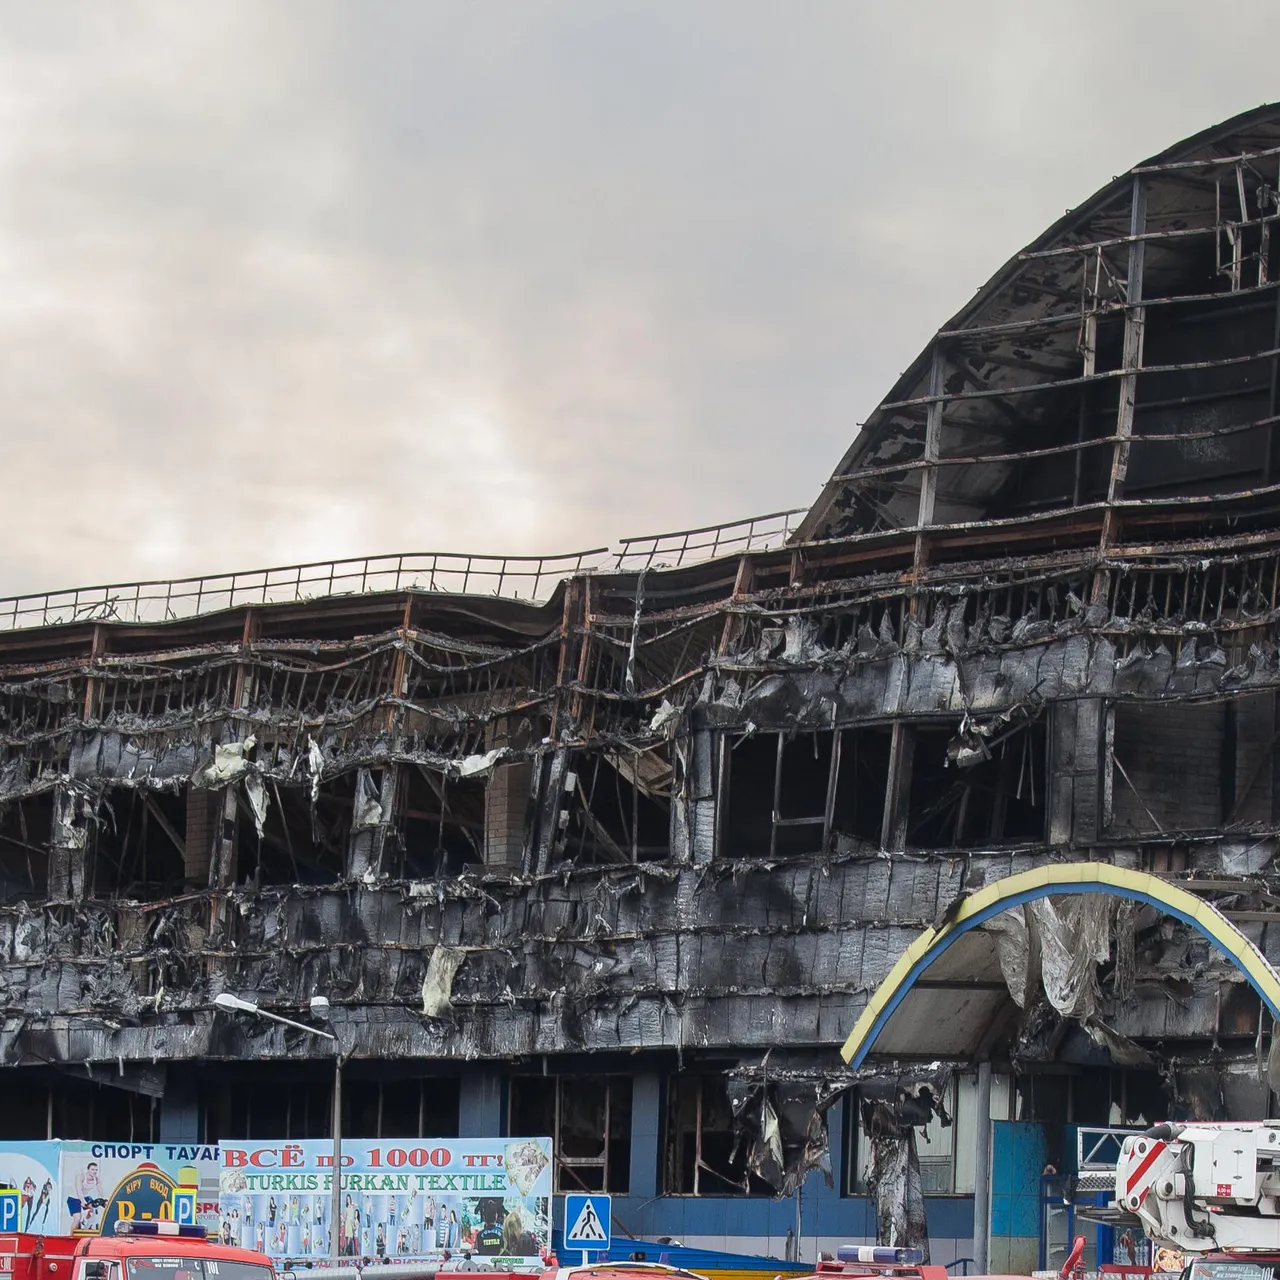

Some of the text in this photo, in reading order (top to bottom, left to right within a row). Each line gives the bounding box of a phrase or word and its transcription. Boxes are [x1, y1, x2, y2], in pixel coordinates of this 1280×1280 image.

[91, 1144, 154, 1159] СПОРТ
[222, 1145, 305, 1168] ВСЁ
[366, 1147, 452, 1168] 1000
[245, 1174, 319, 1191] TURKIS
[414, 1174, 507, 1191] TEXTILE
